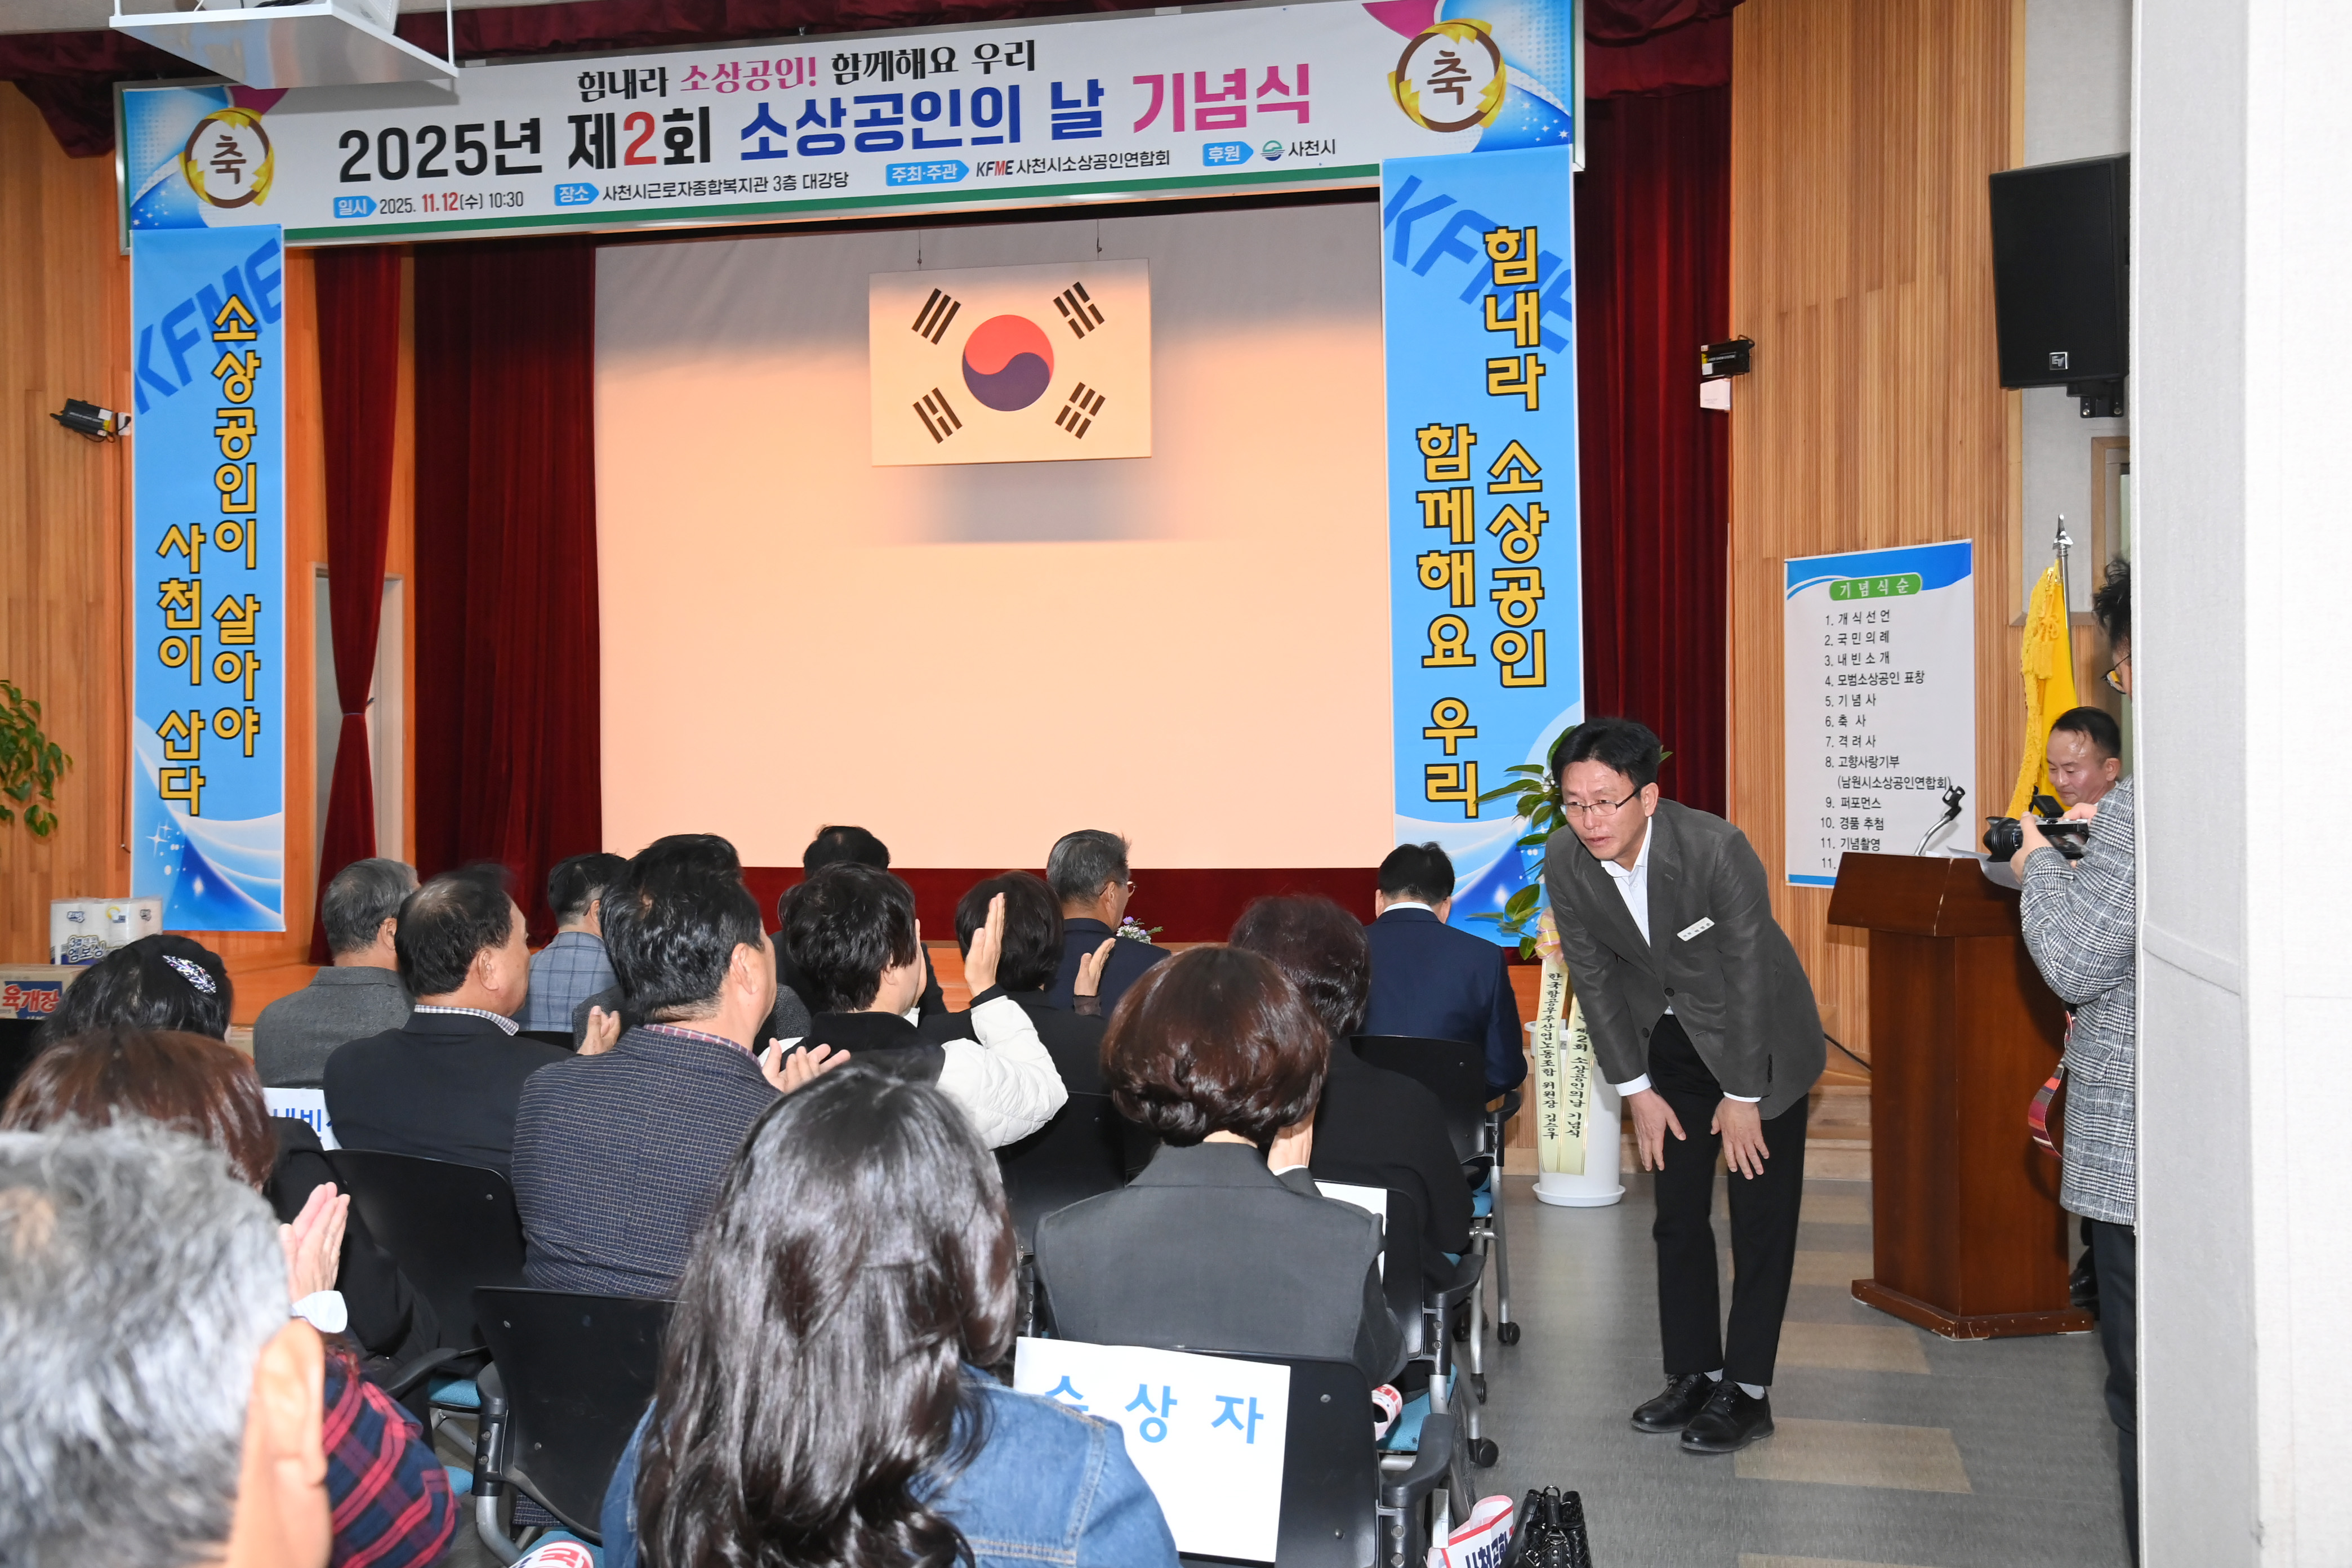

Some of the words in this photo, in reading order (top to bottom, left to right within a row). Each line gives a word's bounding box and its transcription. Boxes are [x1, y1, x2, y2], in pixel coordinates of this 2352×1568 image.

[577, 68, 669, 103] 힘내라
[680, 56, 817, 94] 소상공인!
[832, 46, 957, 85] 함께해요
[972, 39, 1035, 75] 우리
[1427, 50, 1472, 106] 축
[339, 117, 542, 183] 2025년
[567, 106, 711, 171] 제2회
[741, 84, 1021, 161] 소상공인의
[1050, 79, 1104, 141] 날
[1133, 63, 1310, 133] 기념식
[210, 135, 246, 185] 축
[976, 159, 1014, 177] KFME
[1016, 149, 1170, 174] 사천시소상공인연합회
[1207, 144, 1240, 163] 후원
[1288, 139, 1337, 158] 사천시
[559, 186, 590, 203] 장소
[602, 177, 768, 202] 사천시근로자종합복지관
[773, 175, 797, 193] 3층
[803, 171, 849, 189] 대강당
[338, 199, 368, 216] 일시
[380, 198, 416, 214] 2025.
[422, 191, 483, 212] 11.12(수)
[488, 191, 524, 208] 10:30
[134, 238, 281, 415] KFME
[1483, 225, 1546, 412] 힘내라
[211, 293, 261, 570] 소상공인이
[1416, 423, 1477, 669] 함께해요
[1486, 439, 1549, 688] 소상공인
[156, 523, 206, 686] 사천이
[1825, 615, 1834, 626] 1.
[1825, 635, 1833, 646] 2.
[211, 593, 261, 757] 살아야
[1825, 656, 1833, 667] 3.
[1825, 676, 1834, 687] 4.
[1838, 672, 1900, 687] 모범소상공인
[1904, 671, 1925, 684] 표창
[1825, 696, 1834, 707] 5.
[1825, 716, 1834, 727] 6.
[1825, 737, 1834, 747] 7.
[156, 709, 206, 817] 산다
[1423, 697, 1478, 819] 우리
[1825, 756, 1834, 768] 8.
[1838, 755, 1900, 769] 고향사랑기부
[1837, 775, 1952, 791] (남원시소상공인연합회)
[1825, 797, 1834, 809] 9.
[1841, 797, 1881, 810] 퍼포먼스
[1821, 817, 1834, 828] 10.
[1840, 817, 1859, 831] 경품
[1863, 817, 1884, 831] 추첨
[1821, 838, 1835, 849] 11.
[1841, 837, 1880, 852] 기념촬영
[1822, 858, 1836, 869] 11.
[2, 984, 59, 1012] 육개장
[1539, 973, 1562, 1076] 한국항공우주산업노동조합
[1542, 1081, 1558, 1108] 위원장
[1565, 1112, 1582, 1138] 기념식
